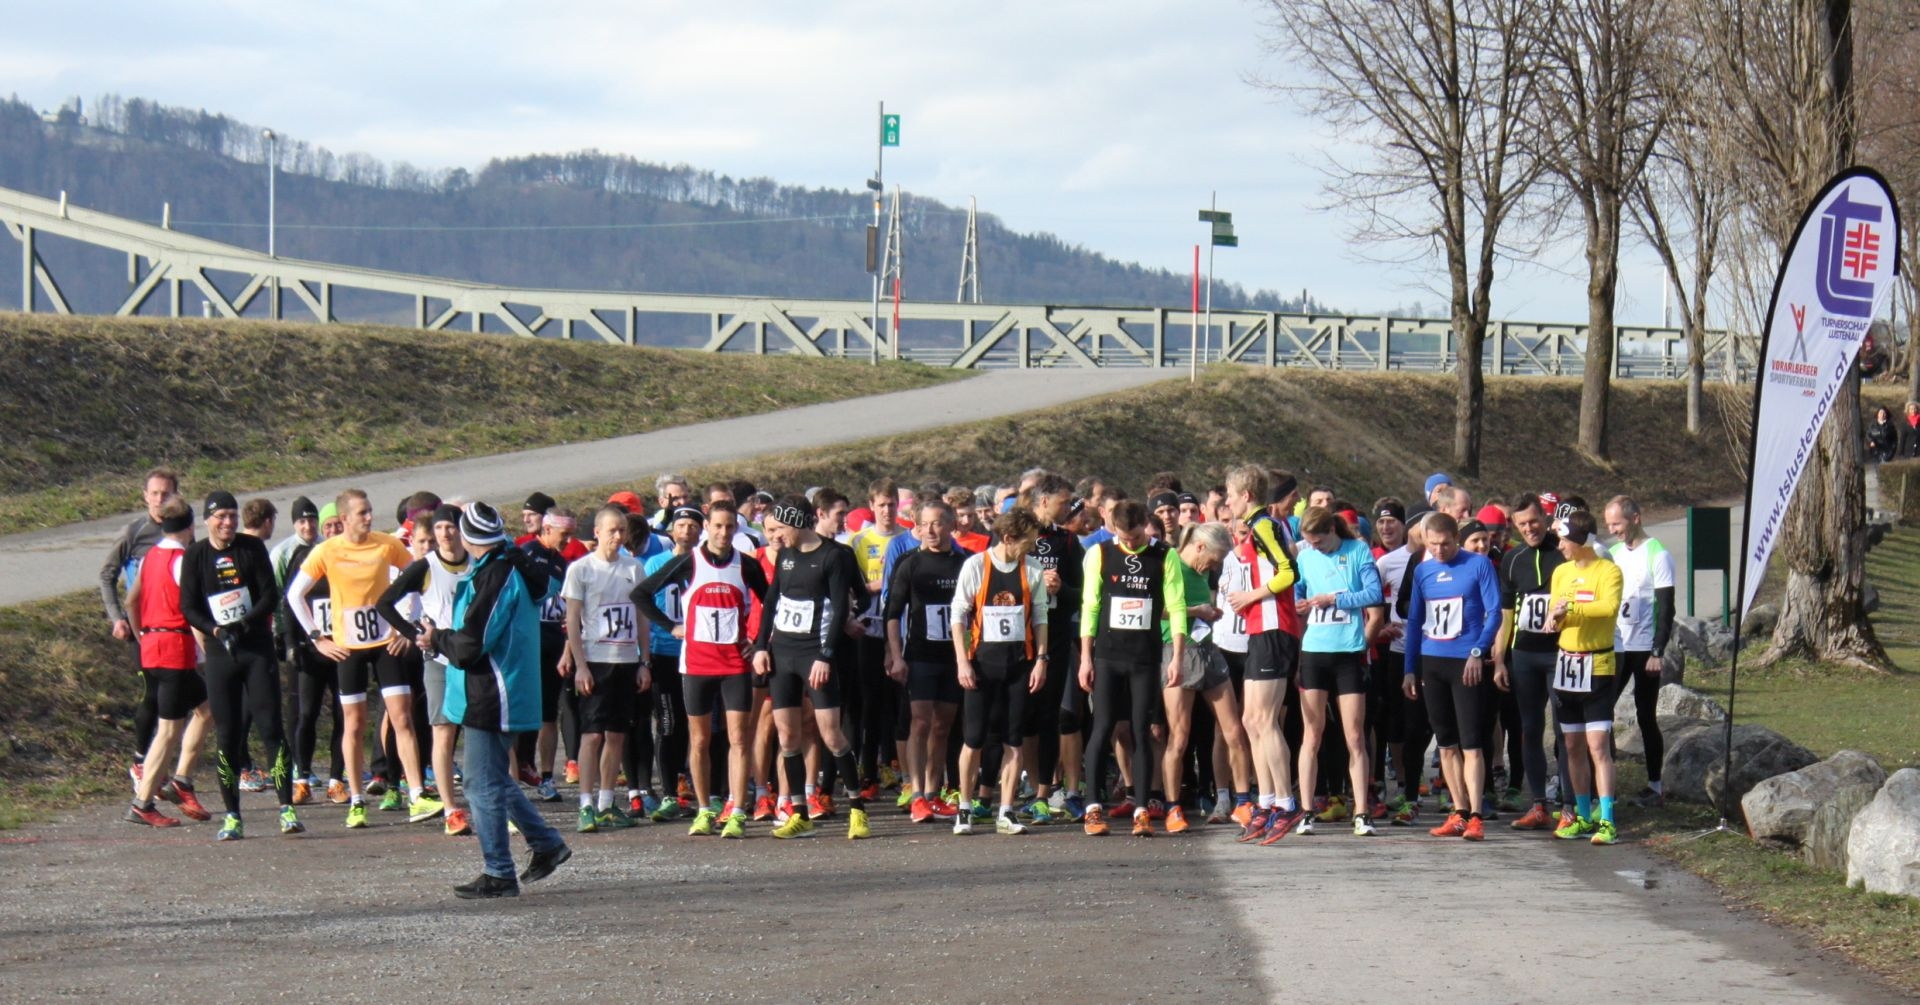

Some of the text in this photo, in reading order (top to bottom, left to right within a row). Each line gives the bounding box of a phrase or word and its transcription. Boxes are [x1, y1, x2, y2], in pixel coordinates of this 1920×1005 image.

[1828, 329, 1860, 341] LUSTENAU
[1772, 360, 1818, 376] VORARLBERGER
[1770, 372, 1817, 389] SPORTVERBAND
[1754, 350, 1848, 563] www.tslustenau.at
[1121, 575, 1150, 583] SPORT
[221, 604, 247, 621] 373
[783, 609, 803, 628] 70
[1119, 613, 1144, 626] 371
[1433, 603, 1451, 636] 11
[354, 607, 380, 642] 98
[603, 606, 633, 639] 174
[711, 610, 719, 641] 1
[999, 618, 1011, 636] 6
[1559, 655, 1585, 688] 141
